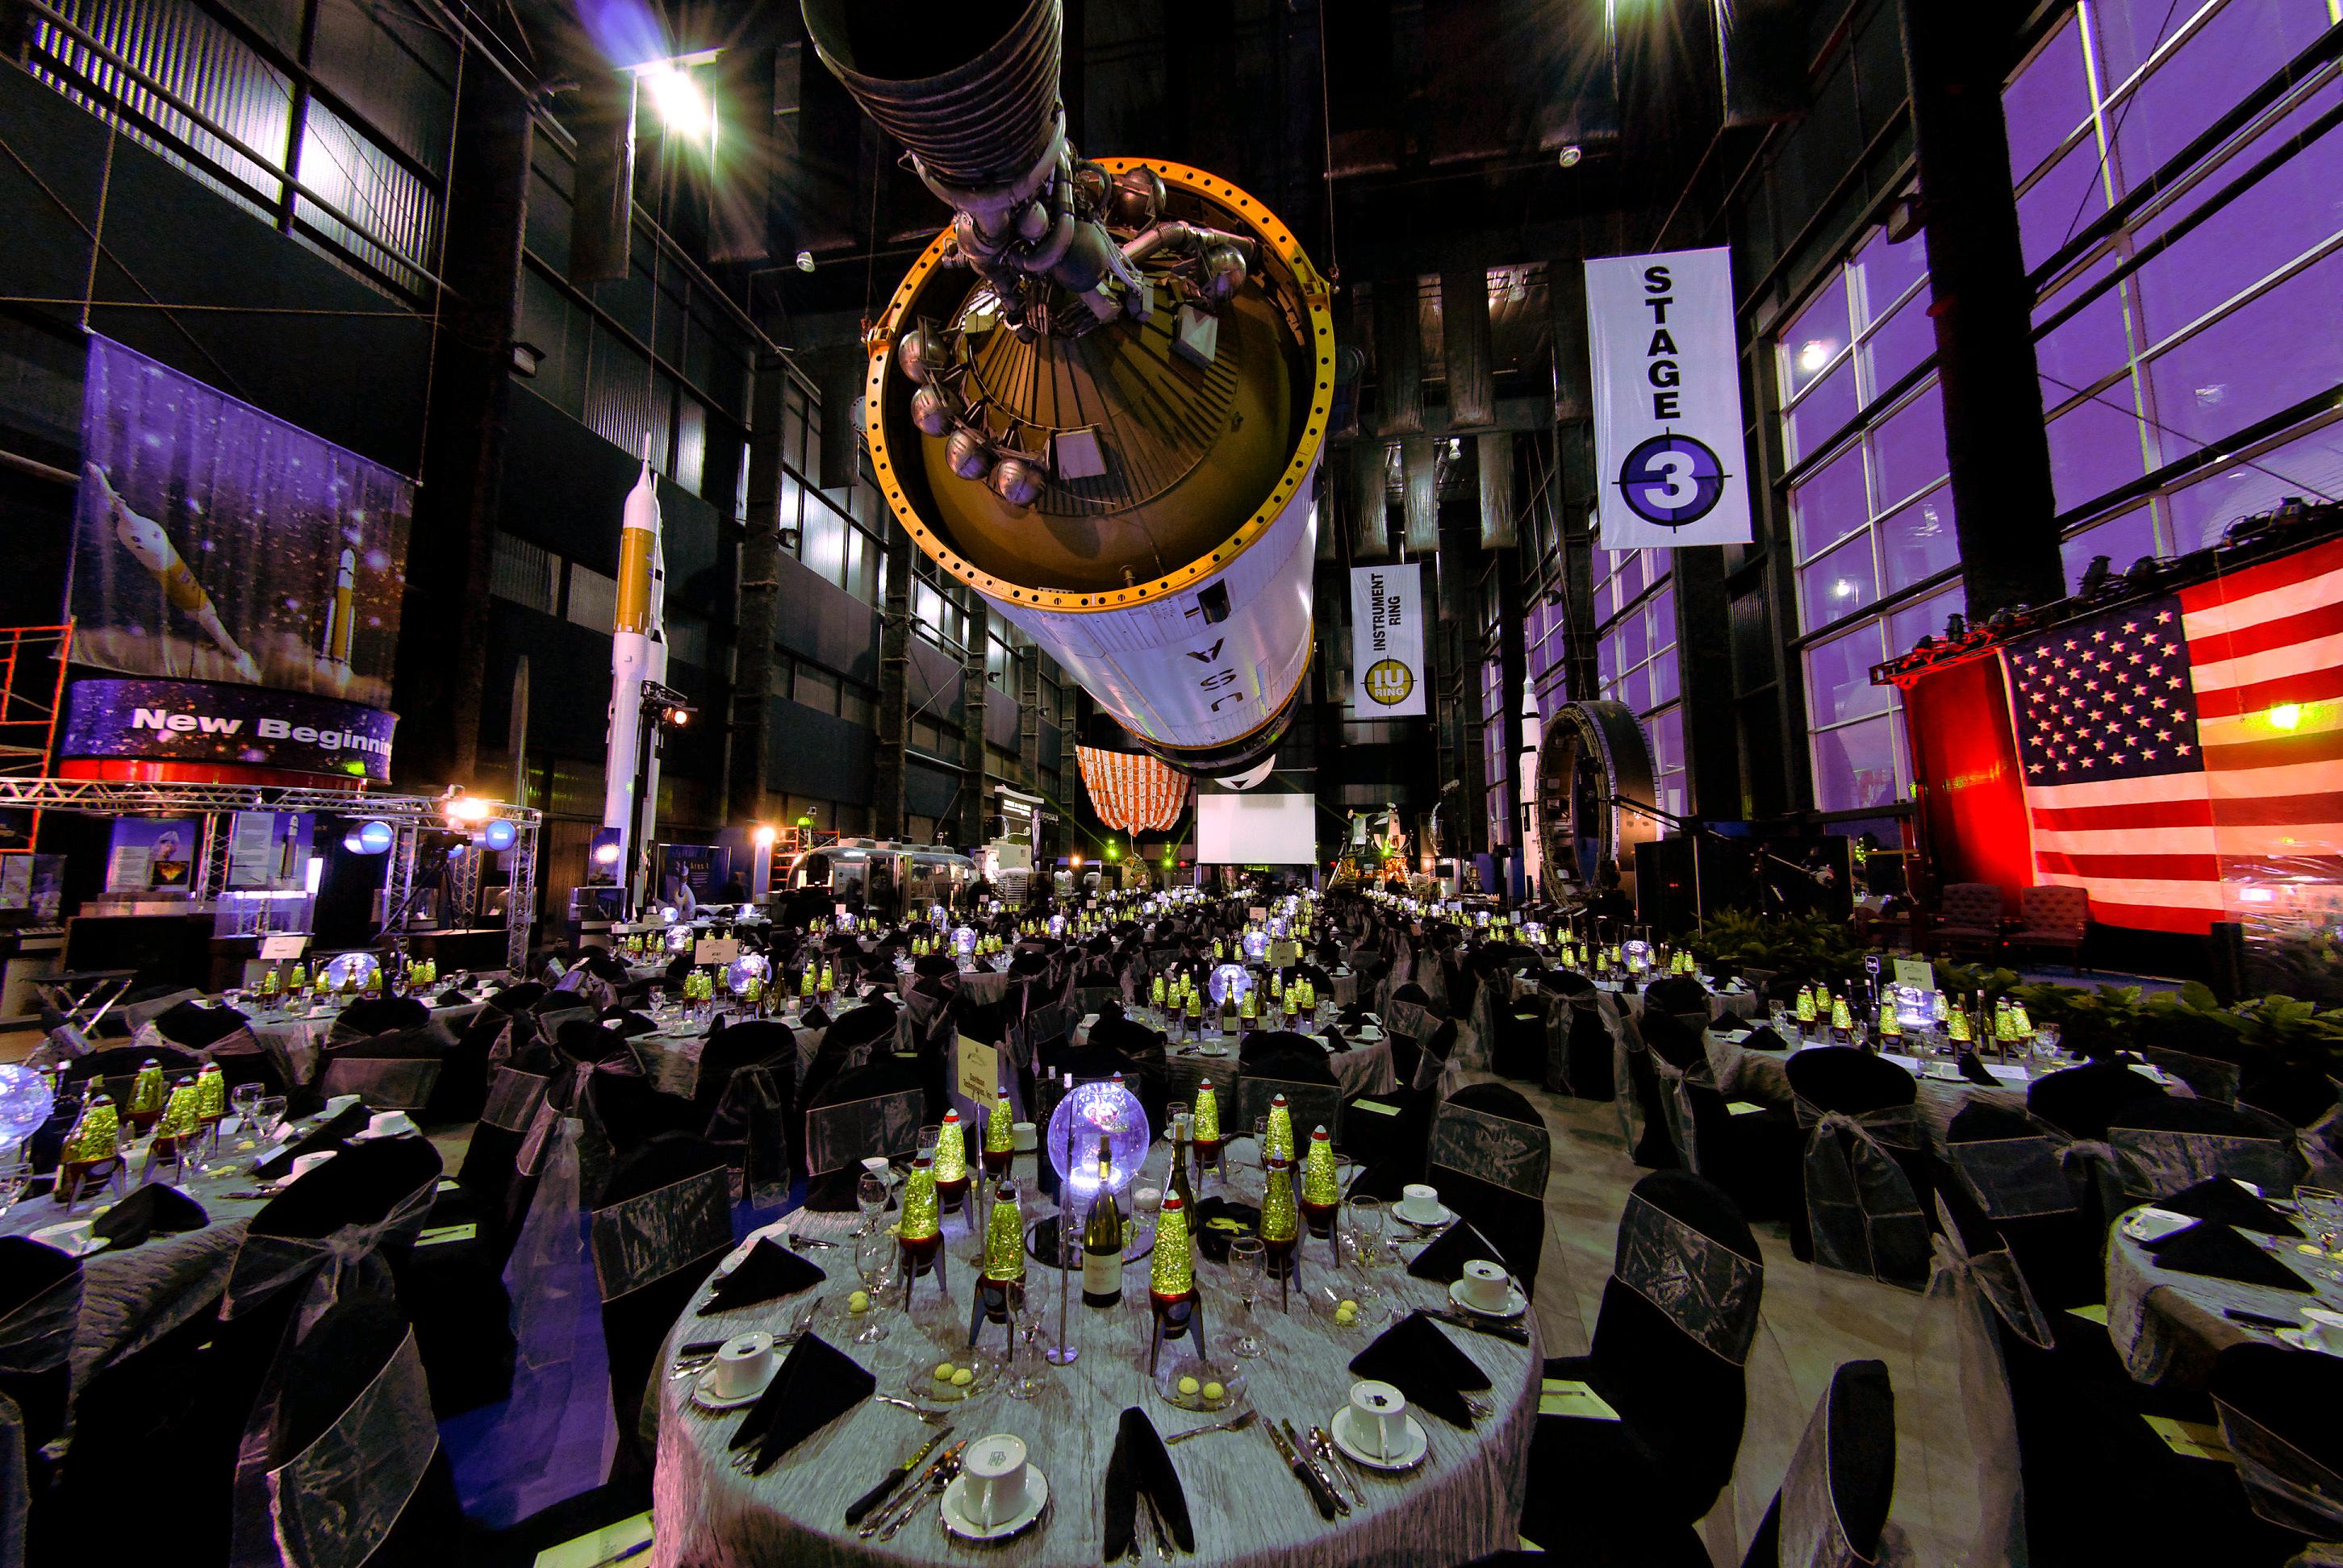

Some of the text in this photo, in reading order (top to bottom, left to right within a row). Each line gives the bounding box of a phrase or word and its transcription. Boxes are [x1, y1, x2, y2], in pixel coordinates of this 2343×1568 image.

[1643, 265, 1681, 420] STAGE
[1643, 451, 1698, 509] 3
[1370, 573, 1386, 652] INSTRUMENT
[1387, 595, 1401, 626] RING
[1186, 636, 1243, 712] USA
[1374, 669, 1405, 688] IU
[1374, 687, 1405, 697] RING
[132, 707, 244, 735] New
